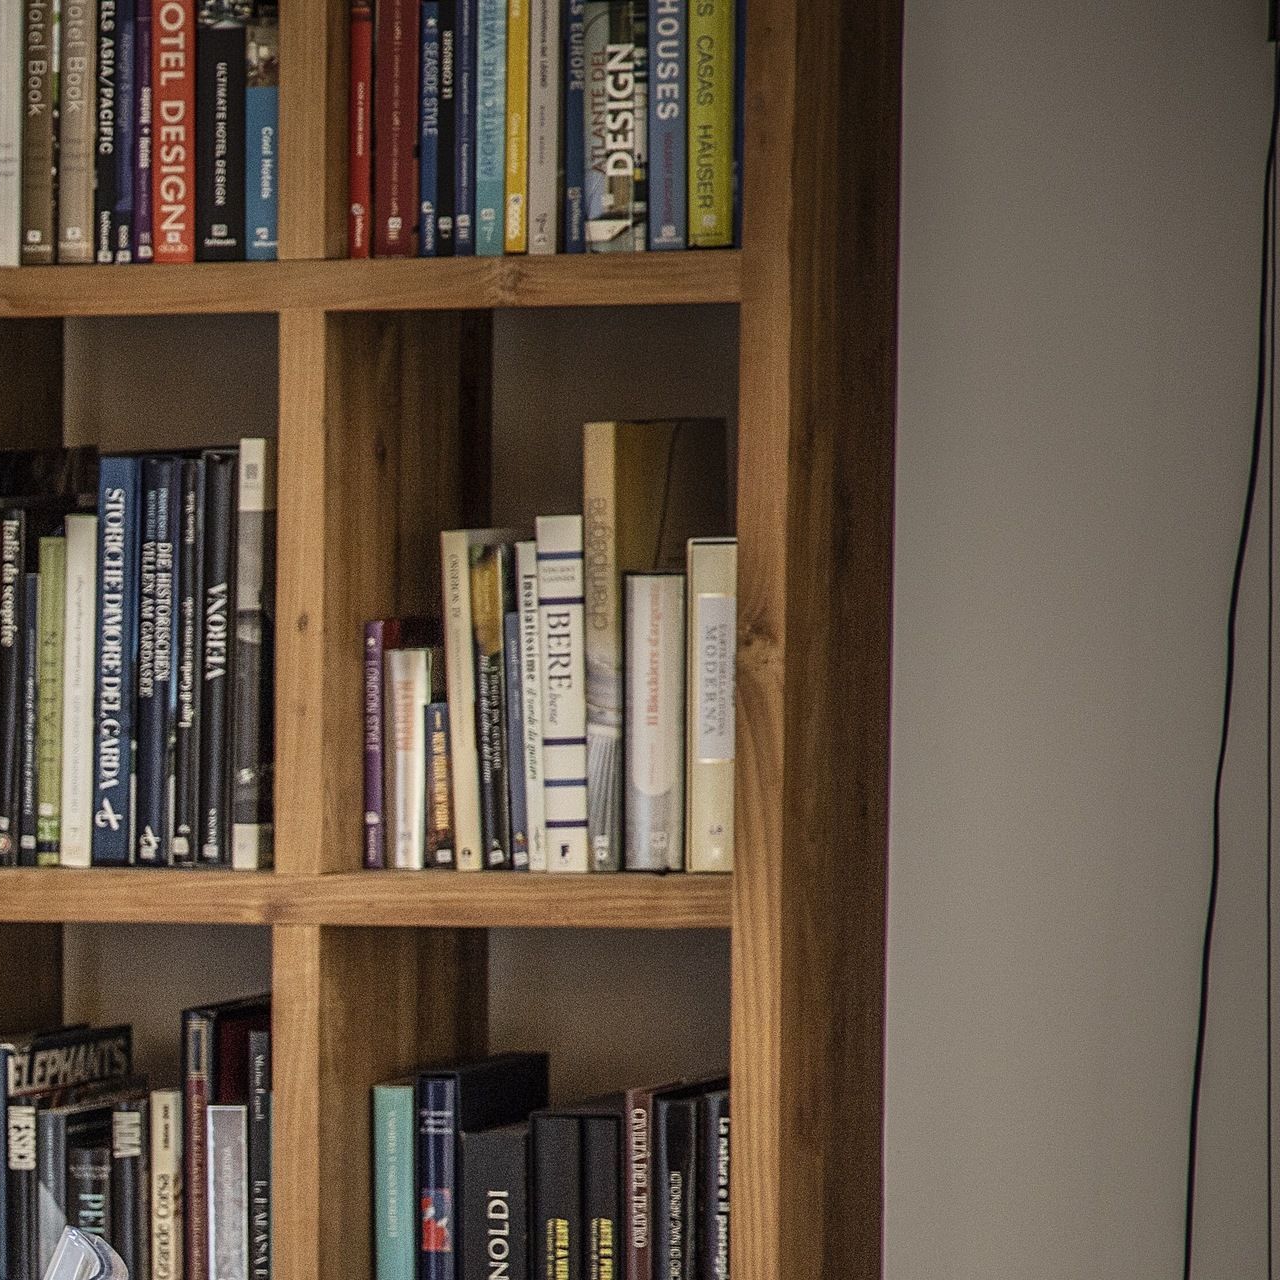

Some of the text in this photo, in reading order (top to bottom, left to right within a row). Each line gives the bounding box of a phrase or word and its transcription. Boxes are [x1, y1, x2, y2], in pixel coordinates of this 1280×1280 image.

[28, 60, 47, 116] Book
[66, 57, 87, 113] Book
[422, 41, 438, 137] SEASIDE STYLE
[569, 22, 584, 91] EUROPE
[696, 34, 715, 107] CASAS
[99, 37, 115, 155] ASIA/PACIFIC
[159, 2, 186, 231] OTEL DESIGN
[590, 46, 606, 175] ATLANTE DEL
[606, 43, 634, 177] DESIGN
[215, 62, 228, 206] ULTIMATE HOTEL DESIGN
[260, 158, 273, 199] Hotels
[104, 487, 126, 592] STORICHE
[587, 496, 613, 632] champagne
[0, 520, 19, 648] Italia da scoprire
[153, 543, 173, 682] DIE HISTORISCHEN
[140, 542, 156, 698] VILLEN AM GARDASEE
[205, 582, 228, 680] VERONA
[522, 574, 539, 681] Insalatissime
[547, 612, 572, 690] BERE
[177, 703, 194, 728] Lago
[704, 625, 719, 736] MODERNA
[99, 719, 122, 790] GARDA
[719, 1117, 730, 1134] La
[633, 1164, 647, 1191] DEL
[670, 1171, 682, 1218] ARNOLDI
[719, 1137, 730, 1185] natura
[719, 1188, 729, 1199] e
[157, 1173, 171, 1220] Corsa
[632, 1195, 647, 1248] TEATRO
[719, 1201, 730, 1212] il
[156, 1223, 171, 1280] Grande
[555, 1218, 568, 1249] ARTE
[599, 1218, 613, 1248] ARTE
[670, 1246, 682, 1258] DI
